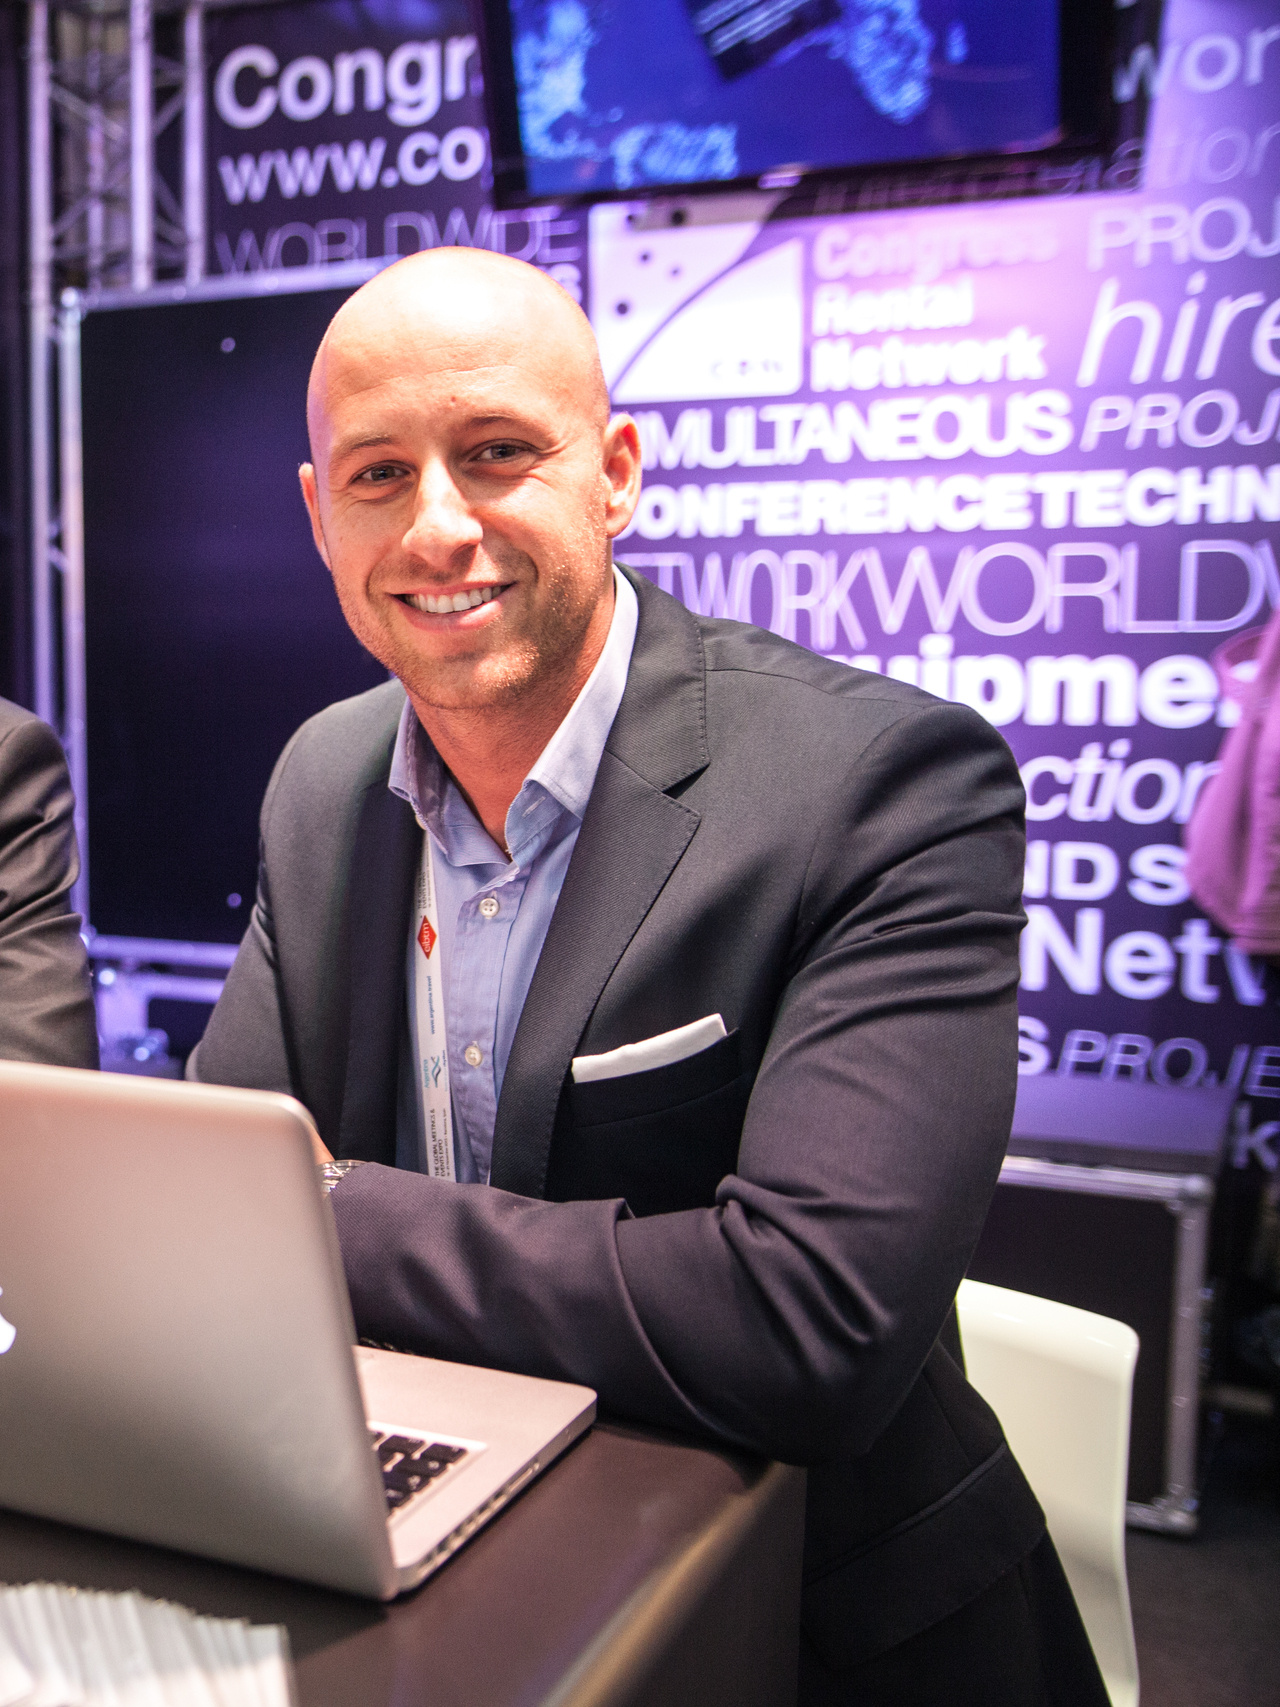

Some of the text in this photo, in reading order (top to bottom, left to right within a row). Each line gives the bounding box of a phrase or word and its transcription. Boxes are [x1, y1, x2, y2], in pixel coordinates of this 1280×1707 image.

[214, 35, 483, 129] Congr
[219, 125, 493, 205] www.co
[813, 222, 1060, 282] Congress
[811, 273, 975, 337] Rental
[809, 326, 1048, 392] Network
[633, 388, 1280, 471] IMULTANEOUS PROJ
[421, 922, 431, 953] eibtm
